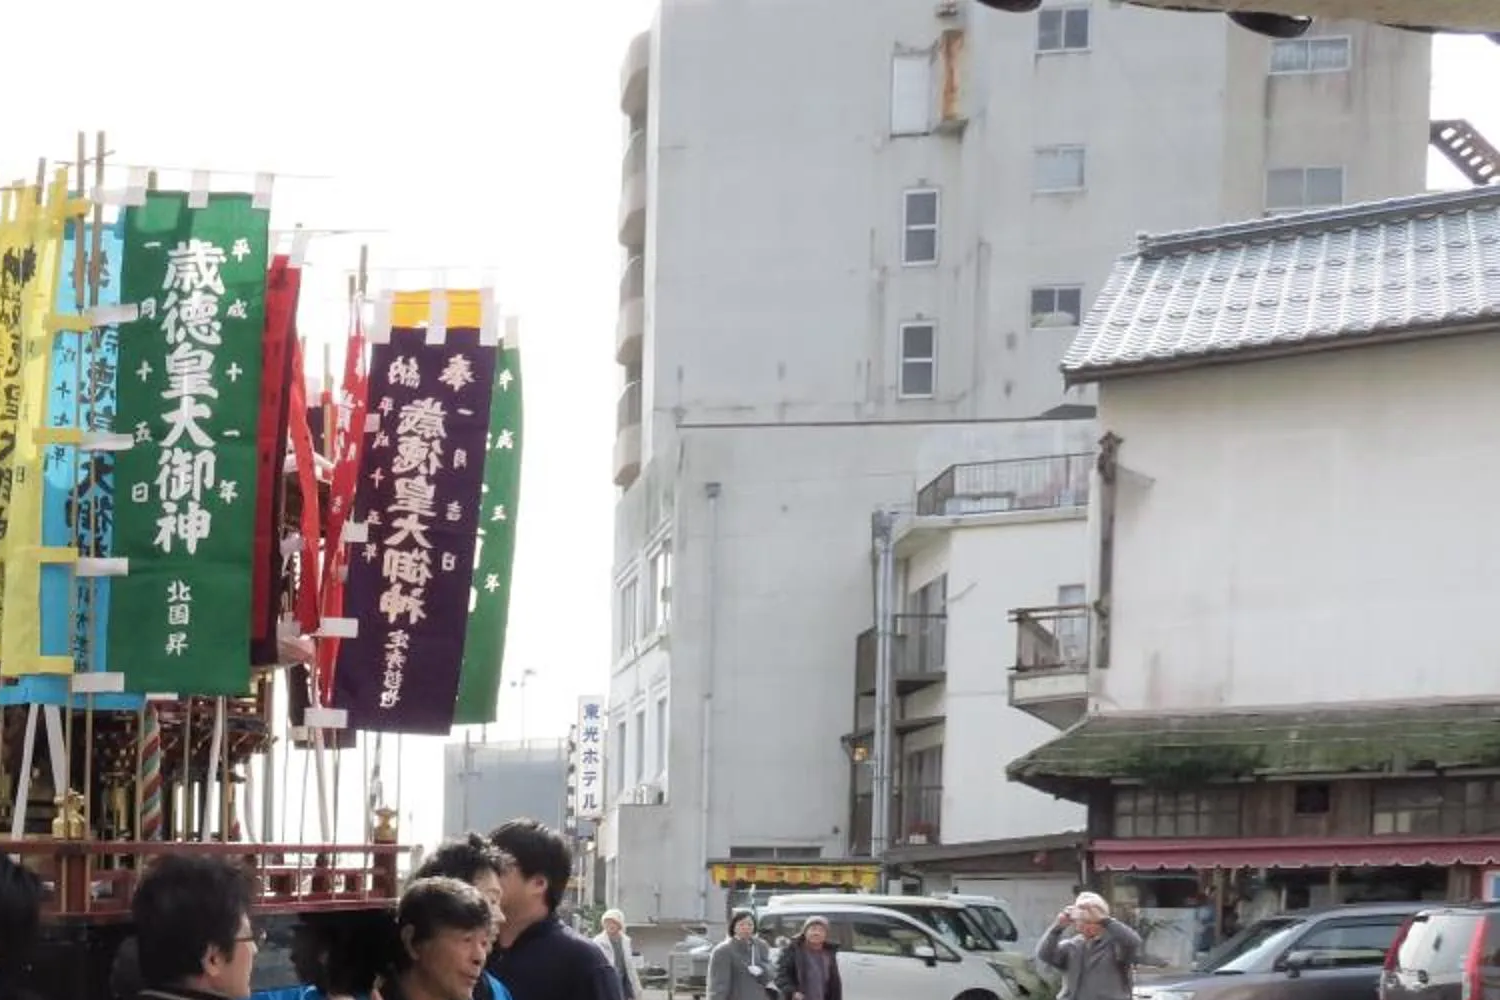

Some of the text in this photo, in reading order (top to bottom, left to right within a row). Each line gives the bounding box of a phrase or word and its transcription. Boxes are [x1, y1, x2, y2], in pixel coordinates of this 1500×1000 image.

[131, 241, 161, 503] 一月十五日
[153, 239, 227, 555] 歳徳皇大御神
[219, 238, 250, 504] 平成十一年
[582, 703, 600, 809] 東光ホテル
